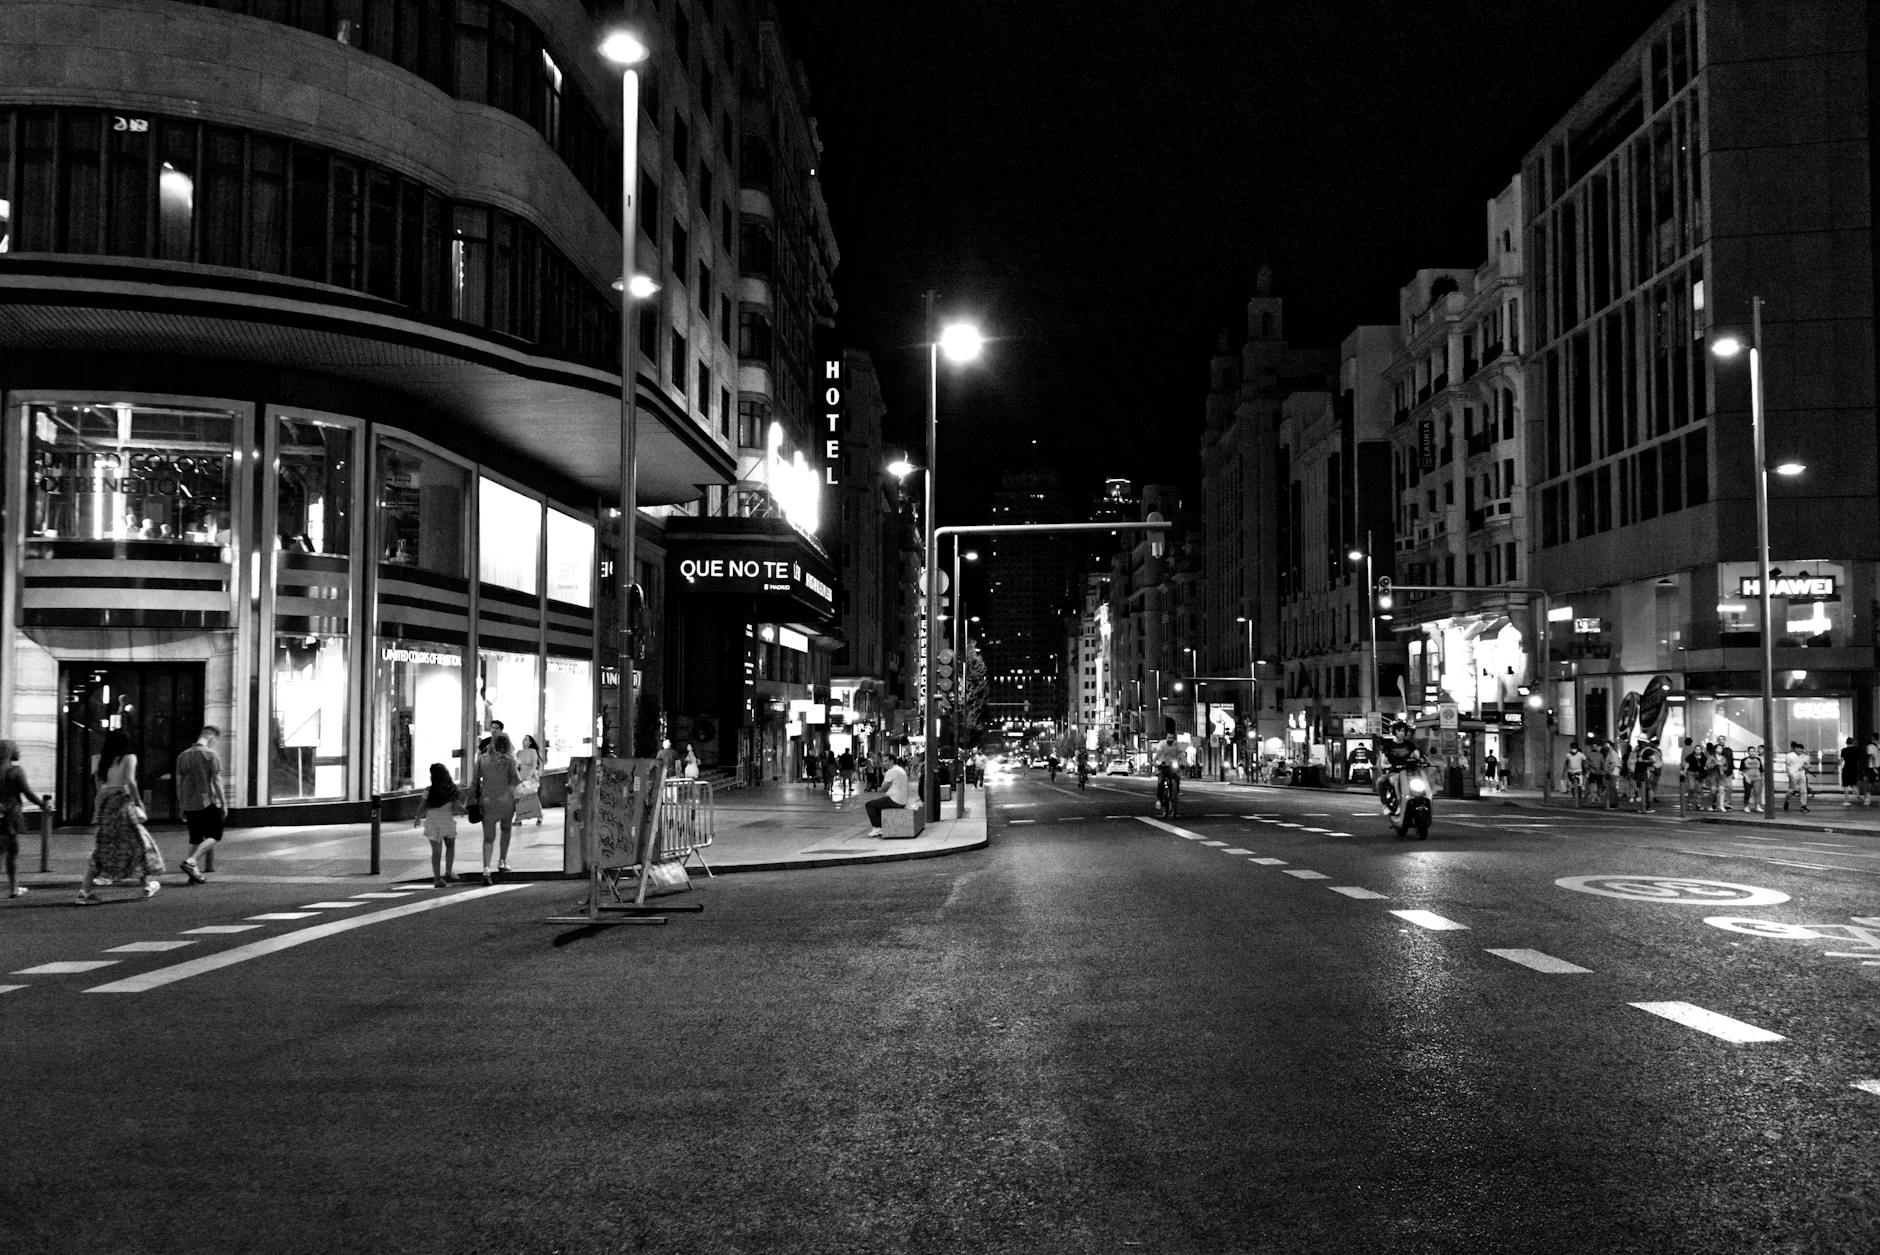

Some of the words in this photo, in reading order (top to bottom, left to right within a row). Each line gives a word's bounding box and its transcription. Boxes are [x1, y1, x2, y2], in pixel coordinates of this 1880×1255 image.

[826, 361, 840, 485] HOTEL
[680, 560, 724, 583] QUE
[729, 560, 760, 577] NO
[763, 561, 789, 579] TE
